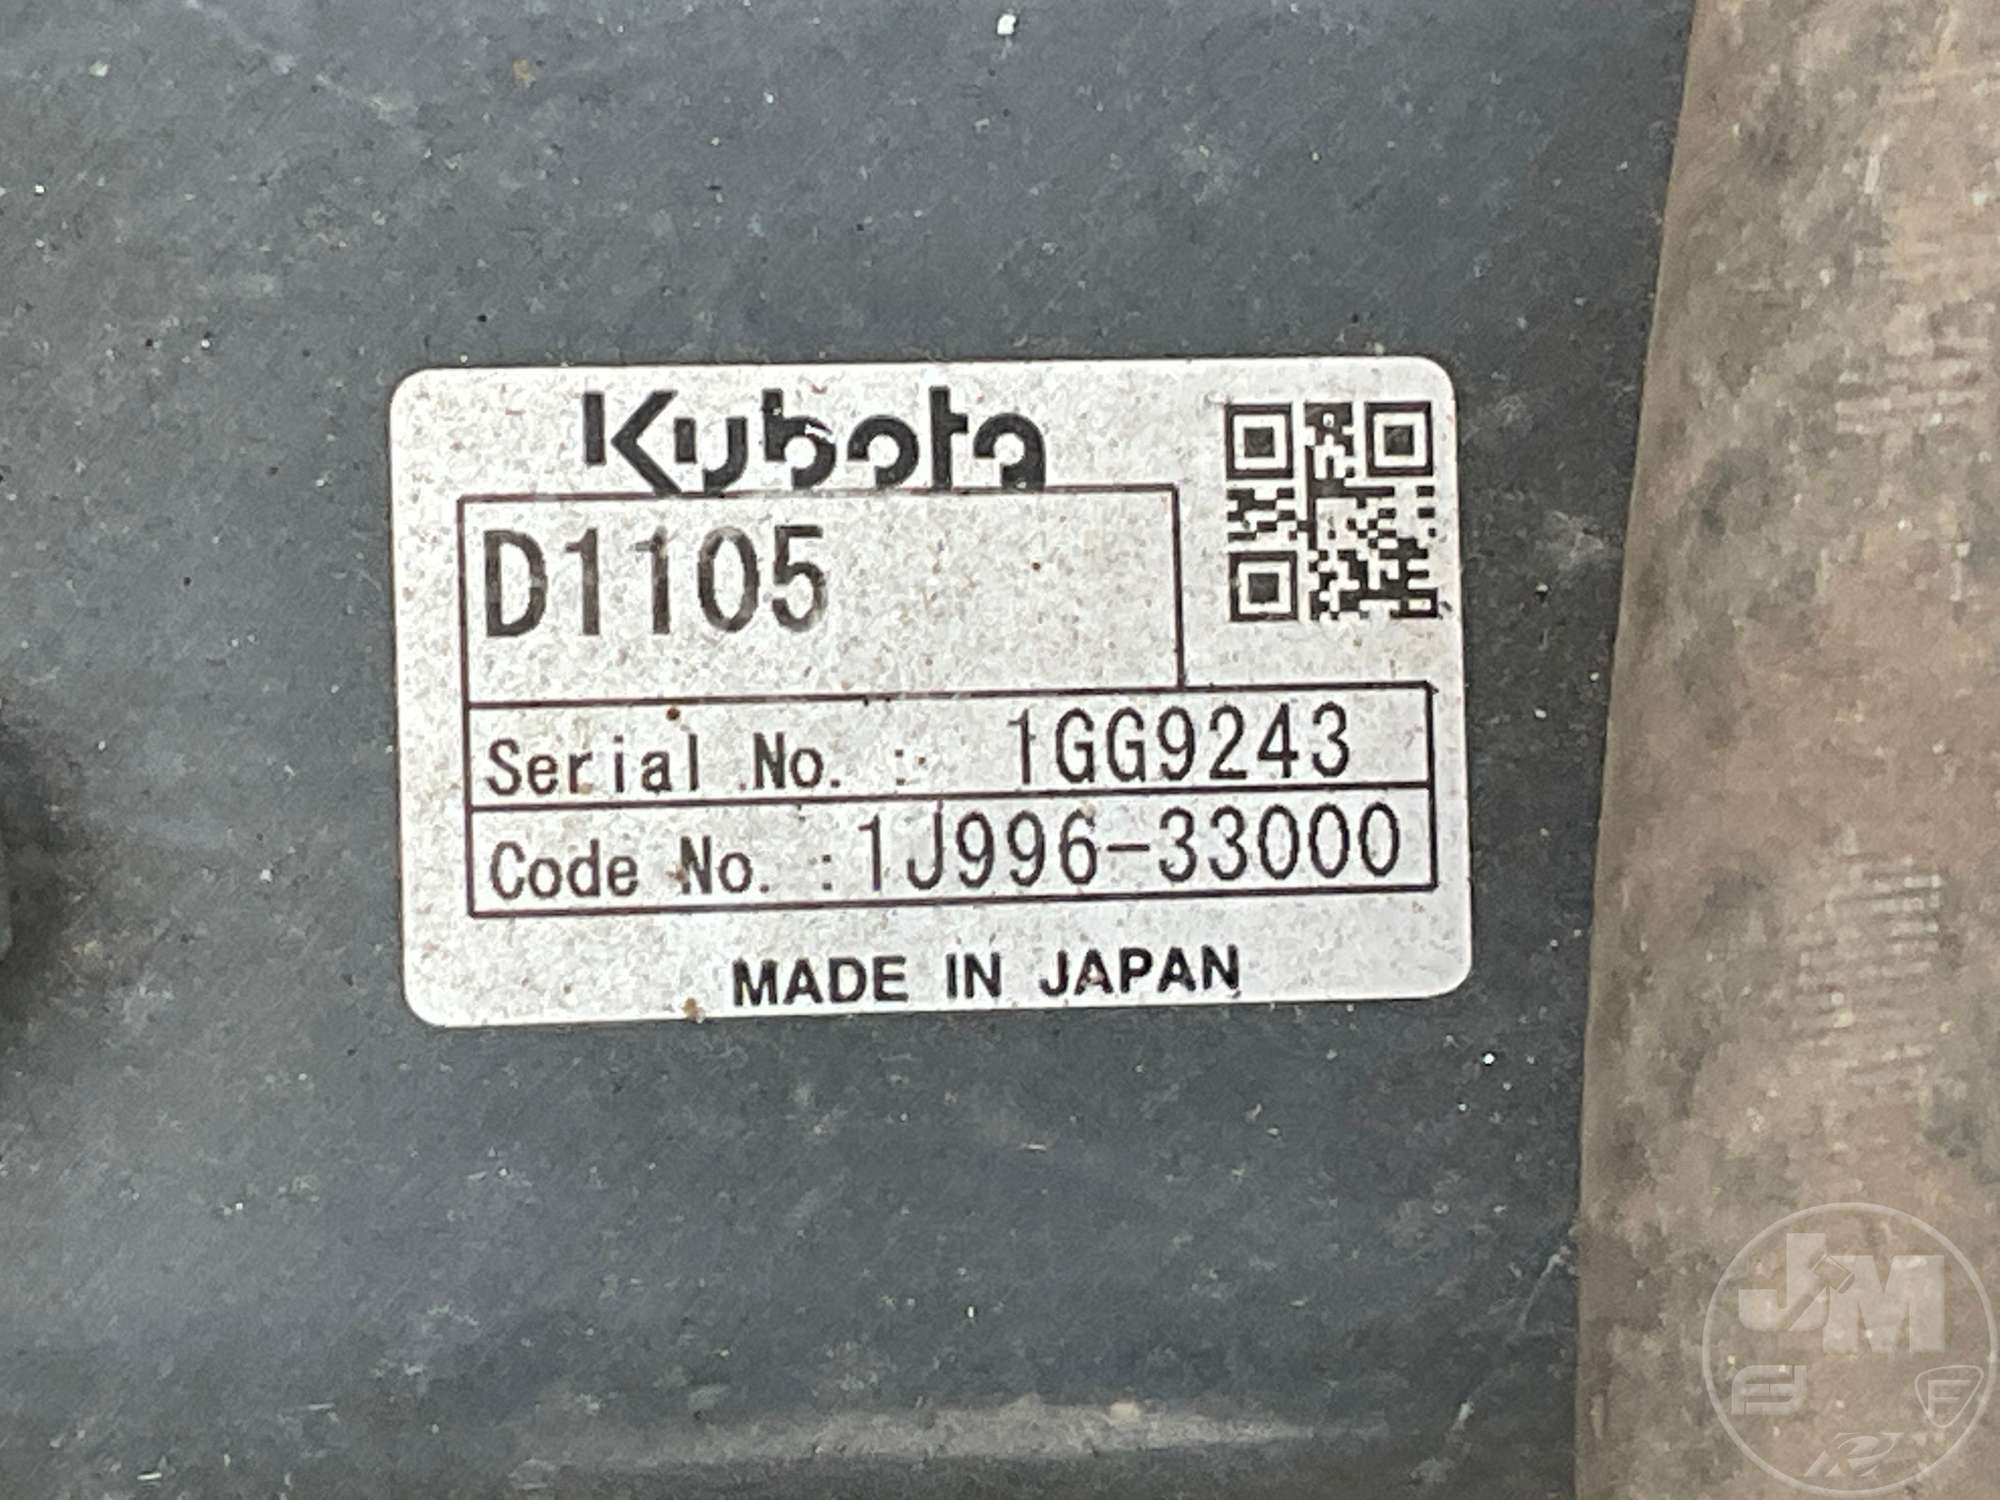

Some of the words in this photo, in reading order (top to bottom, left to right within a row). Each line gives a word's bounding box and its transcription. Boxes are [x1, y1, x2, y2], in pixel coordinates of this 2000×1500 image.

[582, 387, 1046, 494] Kubota
[483, 523, 826, 638] D1105
[487, 735, 699, 796] Serial
[753, 733, 841, 788] No.
[1007, 703, 1350, 785] 1GG9243
[490, 839, 639, 900] Code
[680, 835, 772, 895] No.
[733, 956, 908, 1007] MADE
[947, 953, 1001, 997] IN
[1039, 944, 1241, 996] JAPAN
